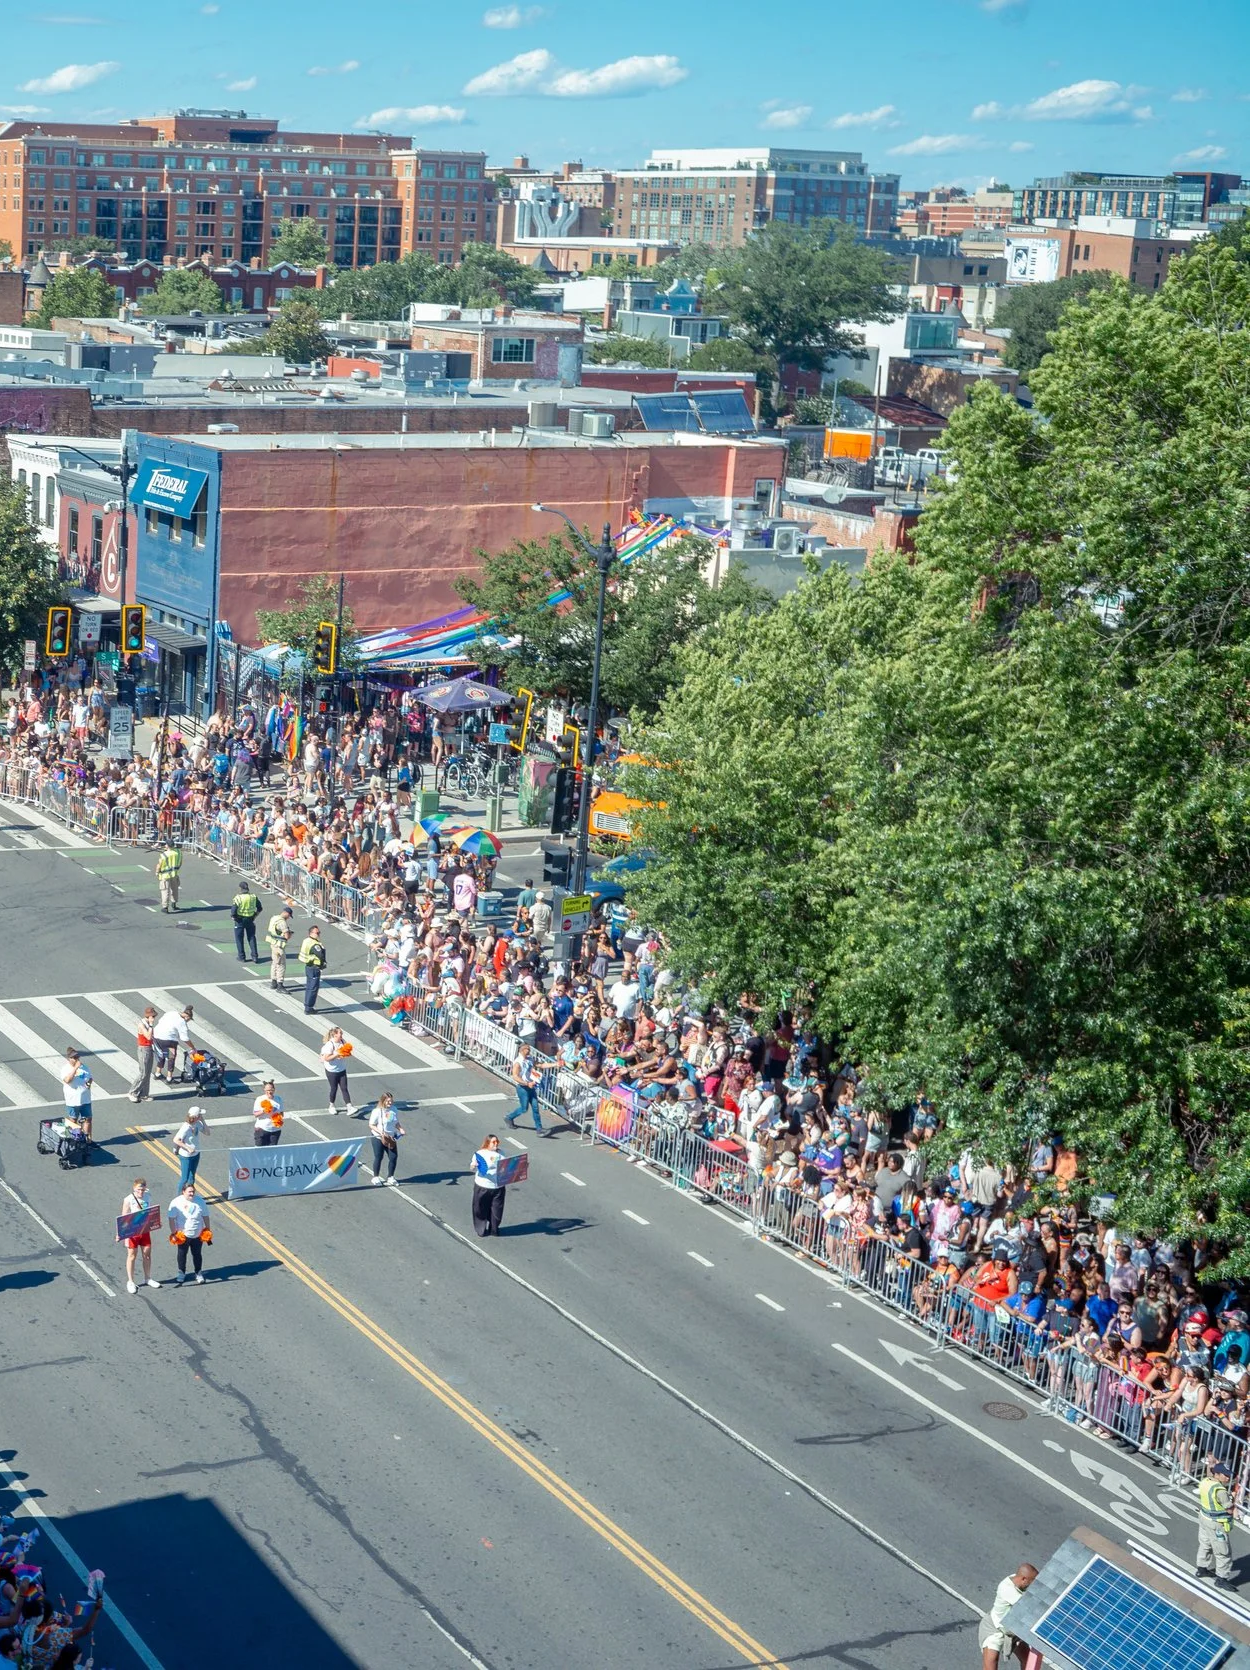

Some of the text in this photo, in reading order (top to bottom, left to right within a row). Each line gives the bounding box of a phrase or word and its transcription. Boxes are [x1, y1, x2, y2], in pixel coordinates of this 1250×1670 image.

[107, 553, 116, 583] C
[113, 722, 130, 732] 25
[252, 1163, 324, 1179] PNC BANK
